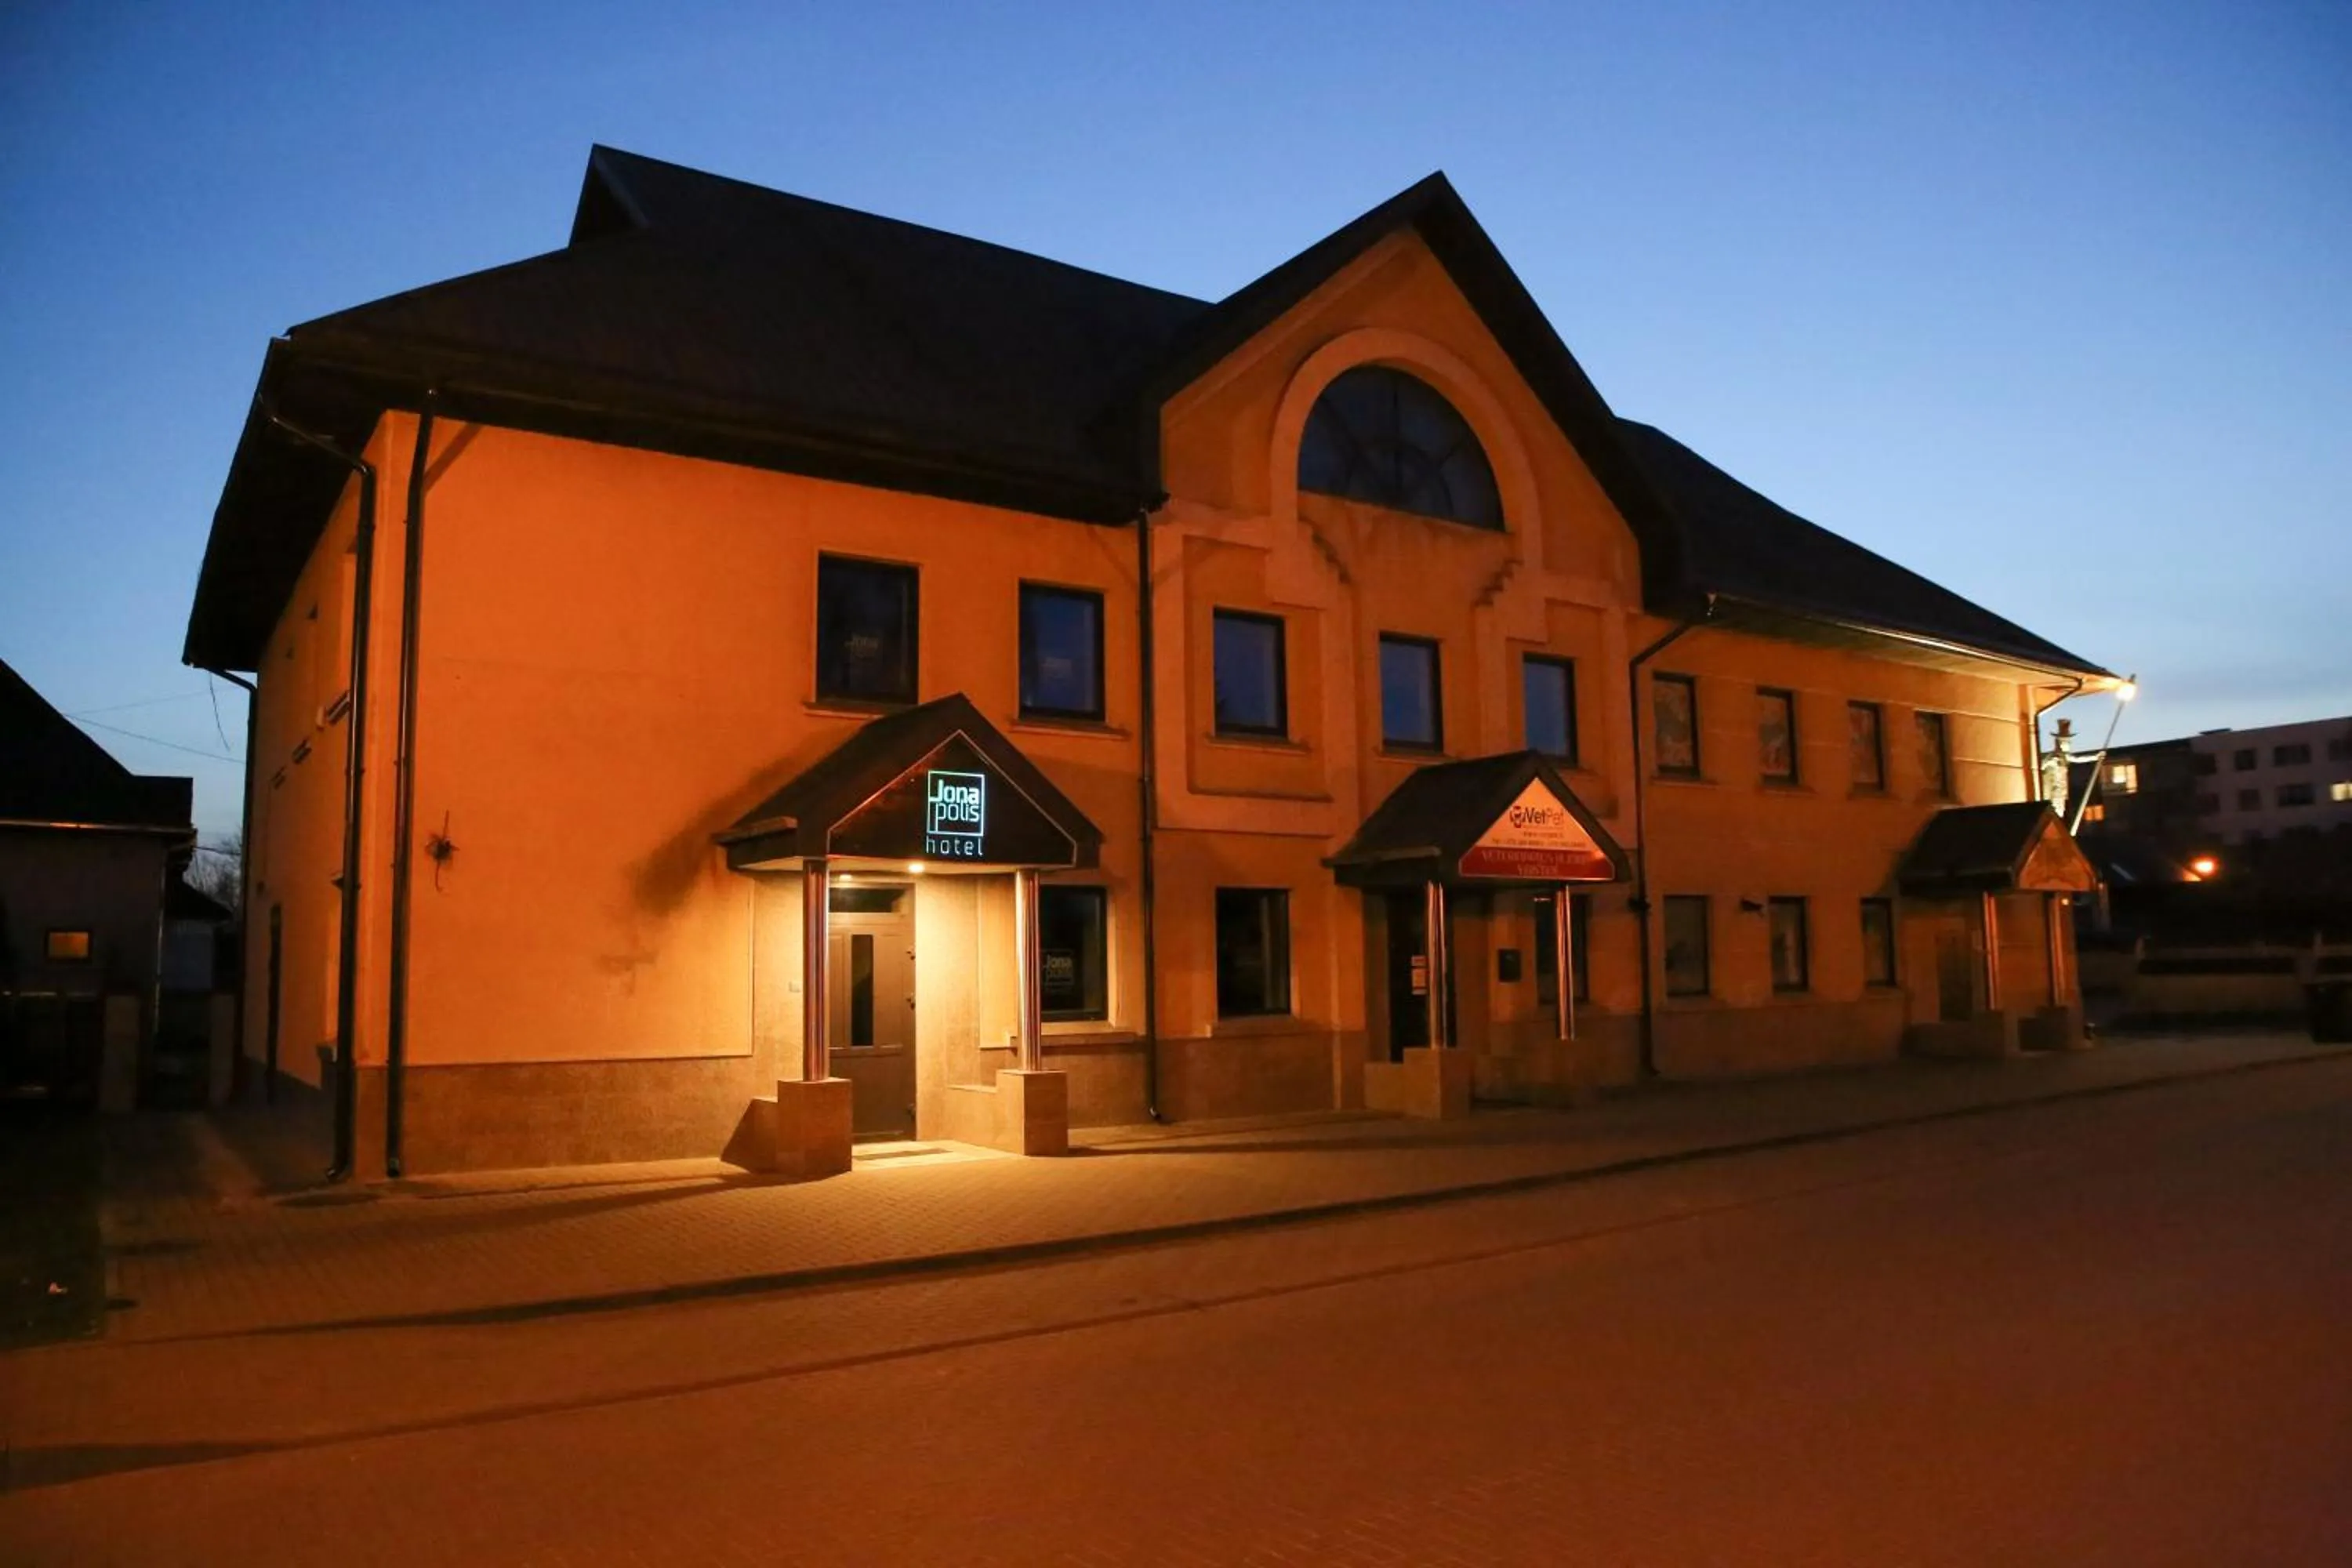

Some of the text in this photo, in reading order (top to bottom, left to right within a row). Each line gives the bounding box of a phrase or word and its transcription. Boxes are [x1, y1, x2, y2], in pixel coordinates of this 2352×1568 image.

[928, 779, 980, 805] Jona
[935, 800, 980, 831] polis
[926, 835, 983, 855] hotel
